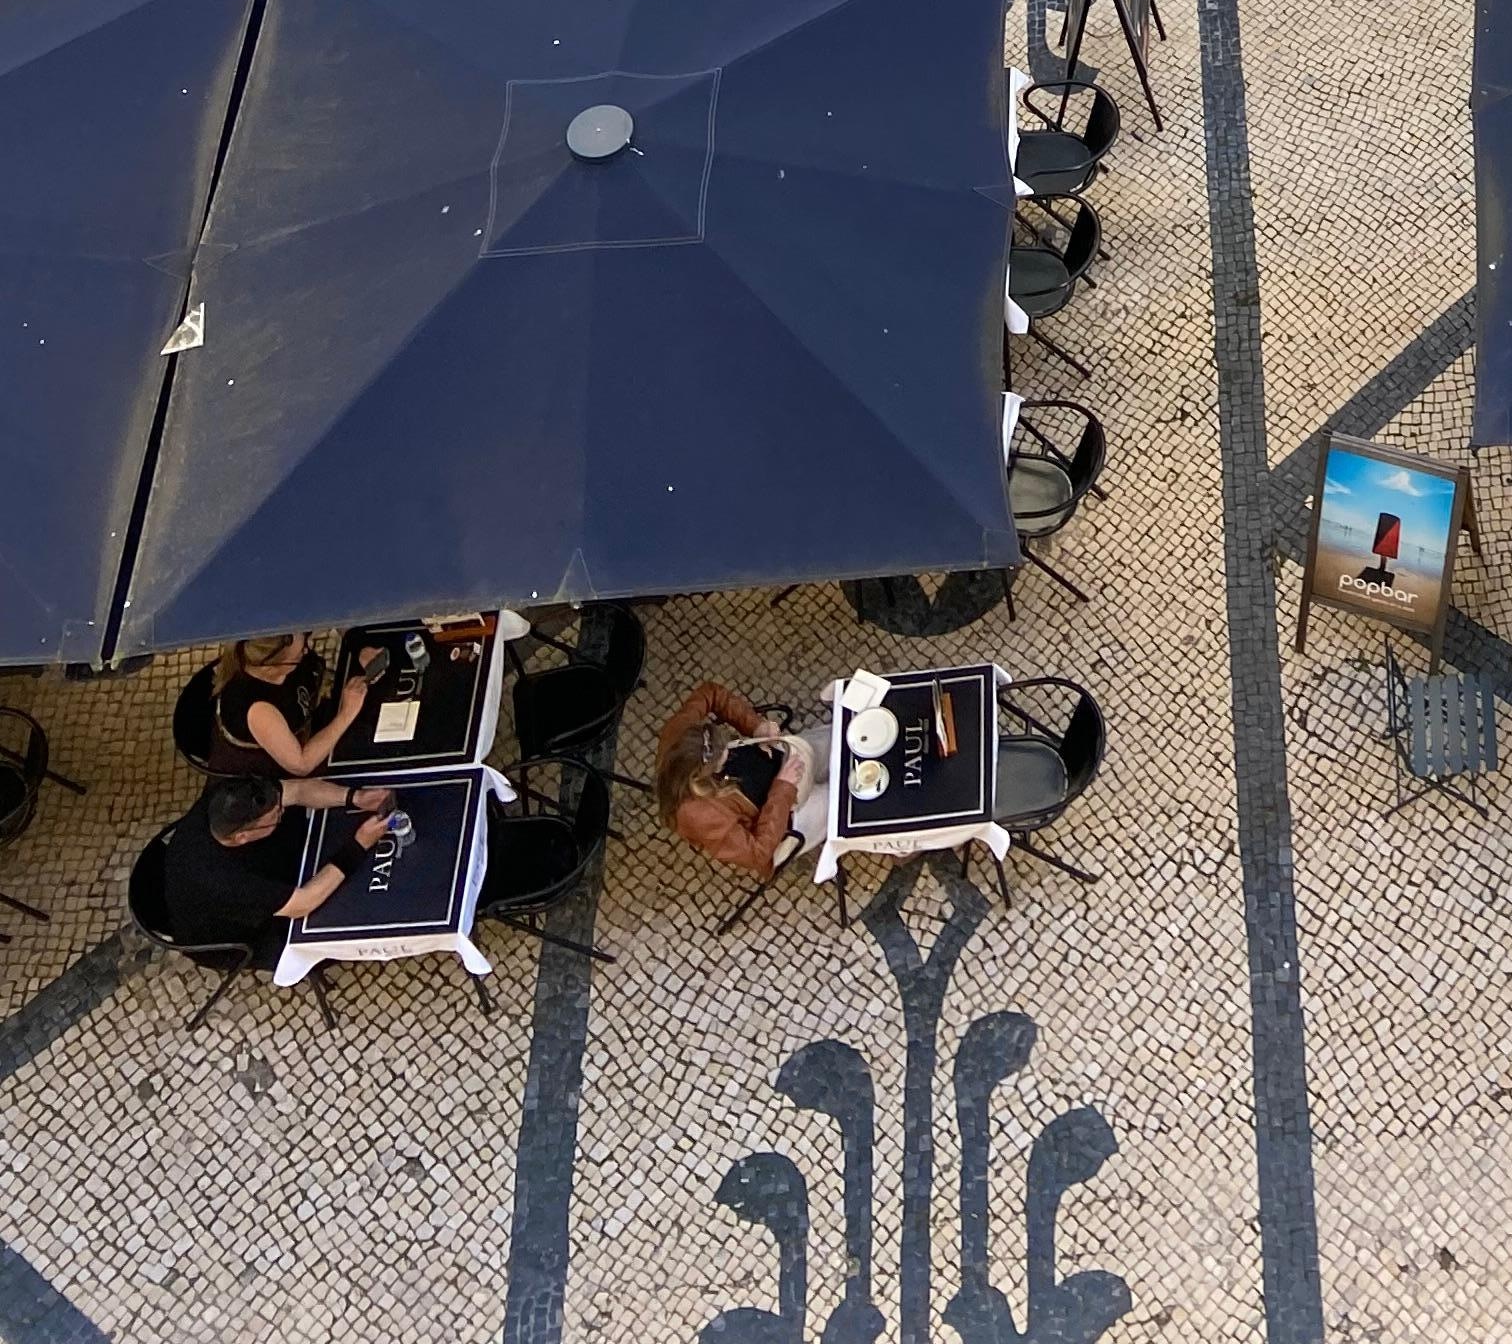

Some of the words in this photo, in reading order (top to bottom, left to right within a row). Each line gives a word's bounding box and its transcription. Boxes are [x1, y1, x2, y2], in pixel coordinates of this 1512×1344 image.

[1339, 573, 1419, 604] popbar
[904, 717, 924, 788] PAUL
[873, 841, 921, 851] PAUL
[358, 944, 413, 957] PAUL
